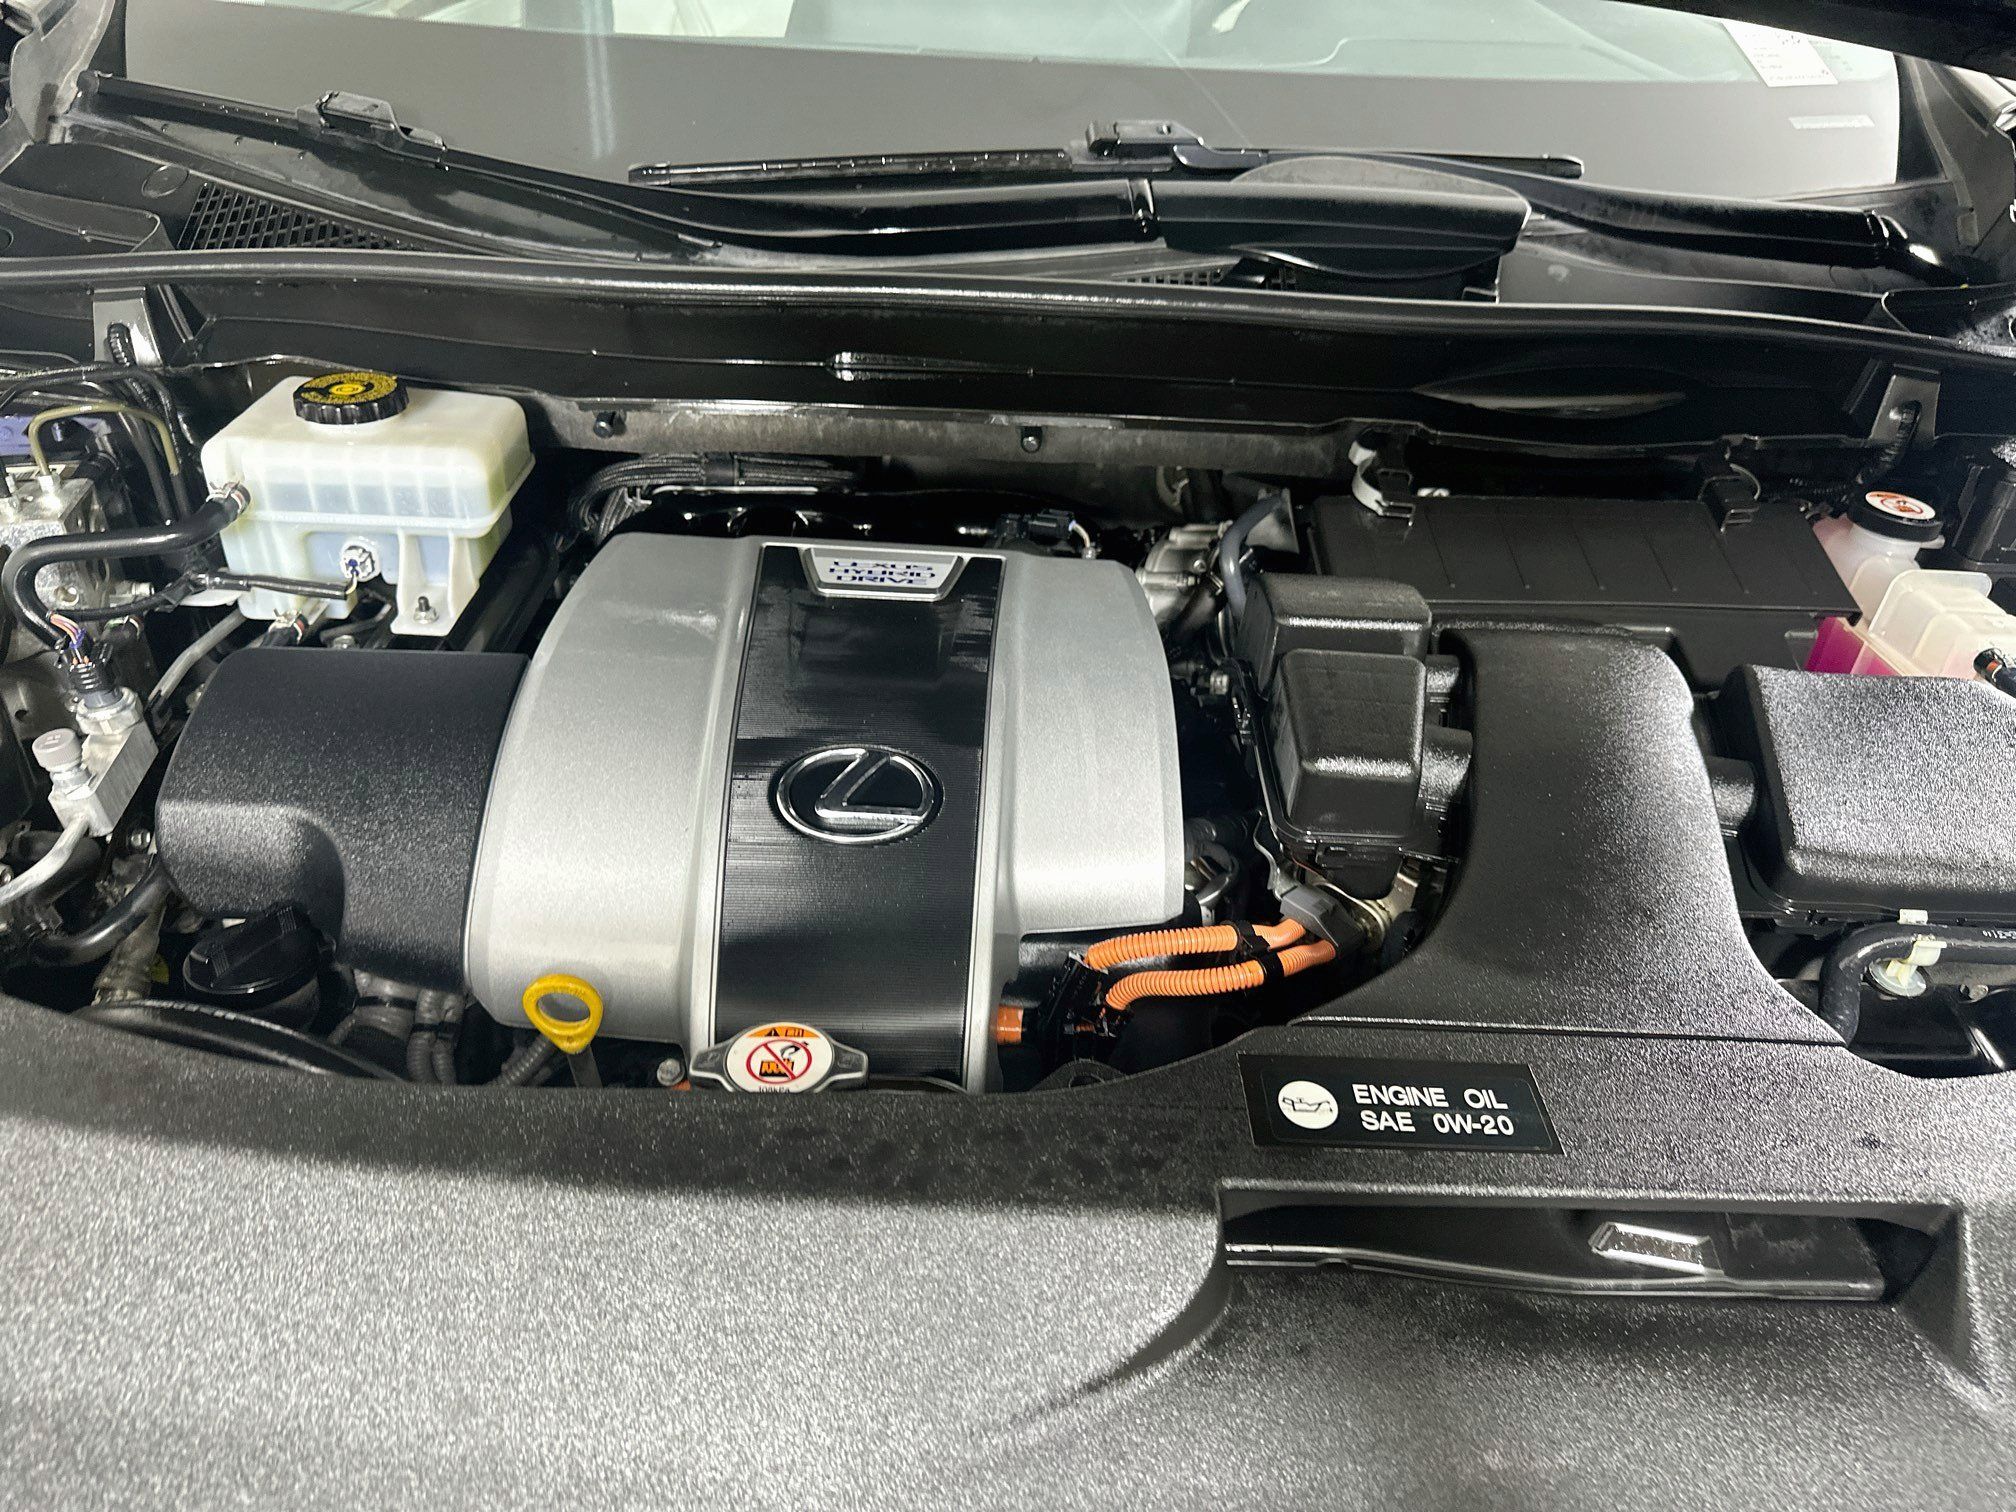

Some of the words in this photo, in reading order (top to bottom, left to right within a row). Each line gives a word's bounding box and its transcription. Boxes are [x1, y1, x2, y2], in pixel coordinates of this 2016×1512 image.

[832, 560, 933, 572] LEXUS
[837, 575, 927, 586] DRIVE
[1352, 1083, 1449, 1108] ENGINE
[1463, 1088, 1509, 1110] OIL
[1360, 1110, 1416, 1133] SAE
[1433, 1114, 1514, 1136] 0W-20
